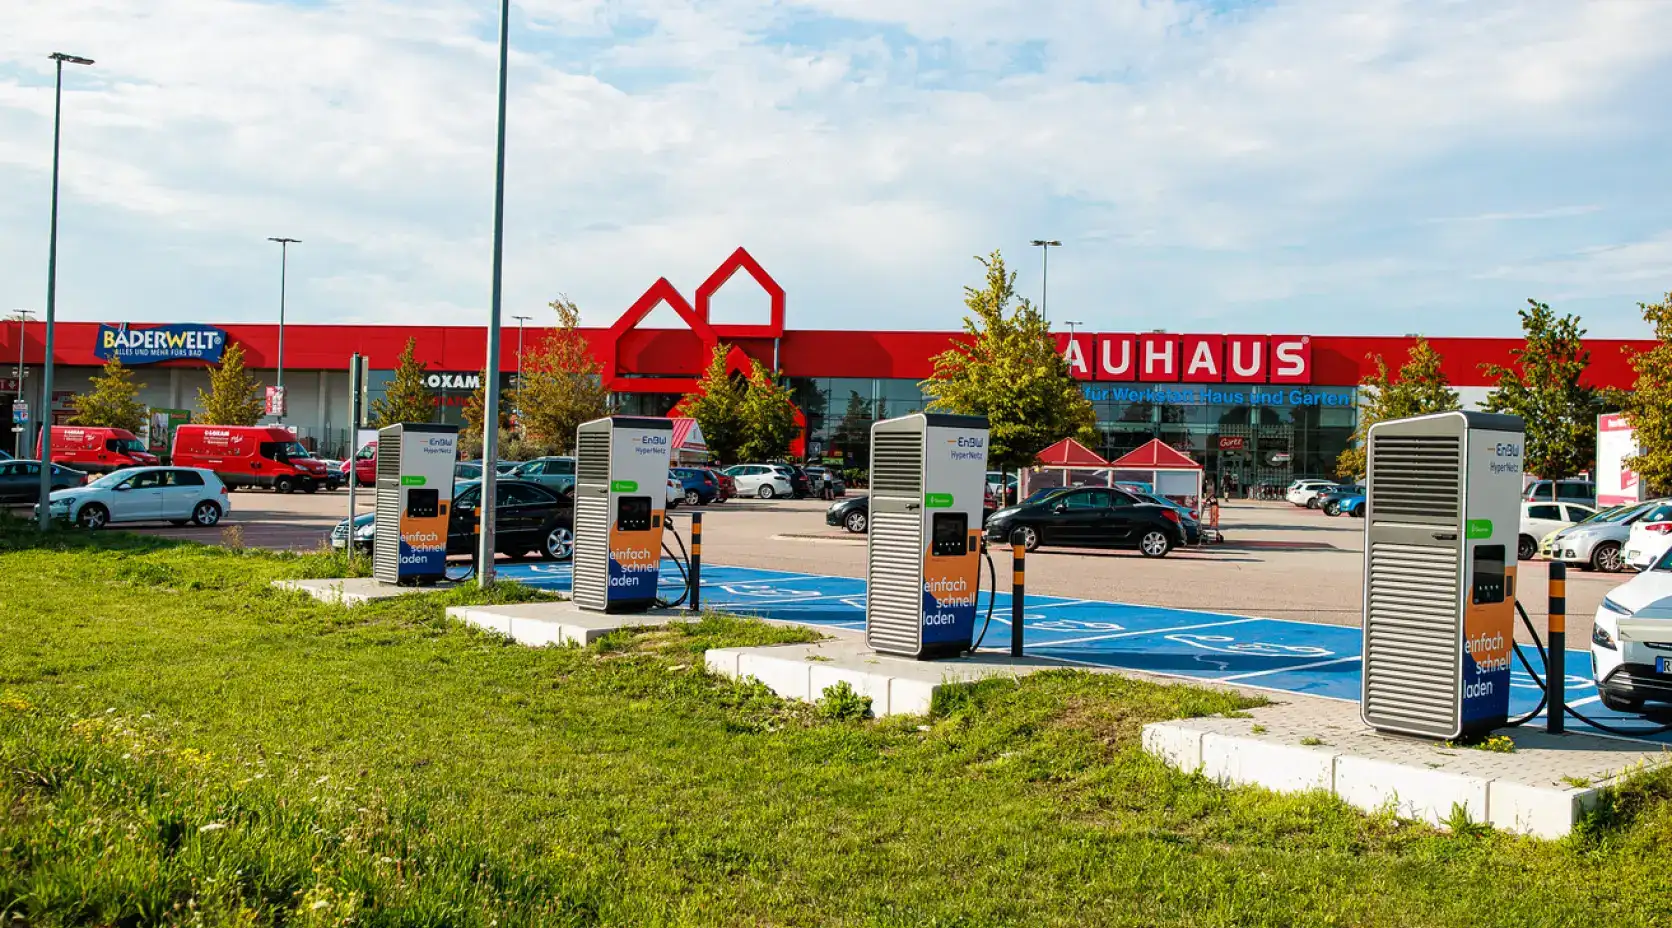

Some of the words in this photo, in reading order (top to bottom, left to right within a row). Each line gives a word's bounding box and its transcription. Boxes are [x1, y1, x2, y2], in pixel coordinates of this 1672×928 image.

[134, 348, 149, 356] UND
[150, 348, 169, 356] MEHR
[188, 348, 202, 356] BAD
[1064, 339, 1305, 377] AUHAUS
[424, 374, 480, 389] OXAM
[1083, 386, 1109, 401] für
[1112, 387, 1194, 403] Werkstatt
[1200, 388, 1244, 404] Haus
[1250, 390, 1283, 405] und
[1289, 390, 1349, 405] Garten
[642, 436, 667, 444] EnBW
[957, 436, 984, 448] EnBW
[635, 447, 667, 456] HyperNetz
[951, 451, 983, 460] HyperNetz
[1496, 443, 1520, 457] EnBW
[1489, 461, 1519, 474] HyperNetz
[400, 531, 438, 542] einfach
[411, 542, 447, 553] schnell
[610, 547, 651, 560] einfach
[399, 553, 428, 564] laden
[621, 559, 659, 573] schnell
[608, 574, 639, 587] laden
[924, 576, 967, 592] einfach
[936, 592, 976, 608] schnell
[922, 610, 955, 626] laden
[1464, 631, 1504, 654] einfach
[1475, 651, 1511, 675] schnell
[1463, 677, 1493, 699] laden
